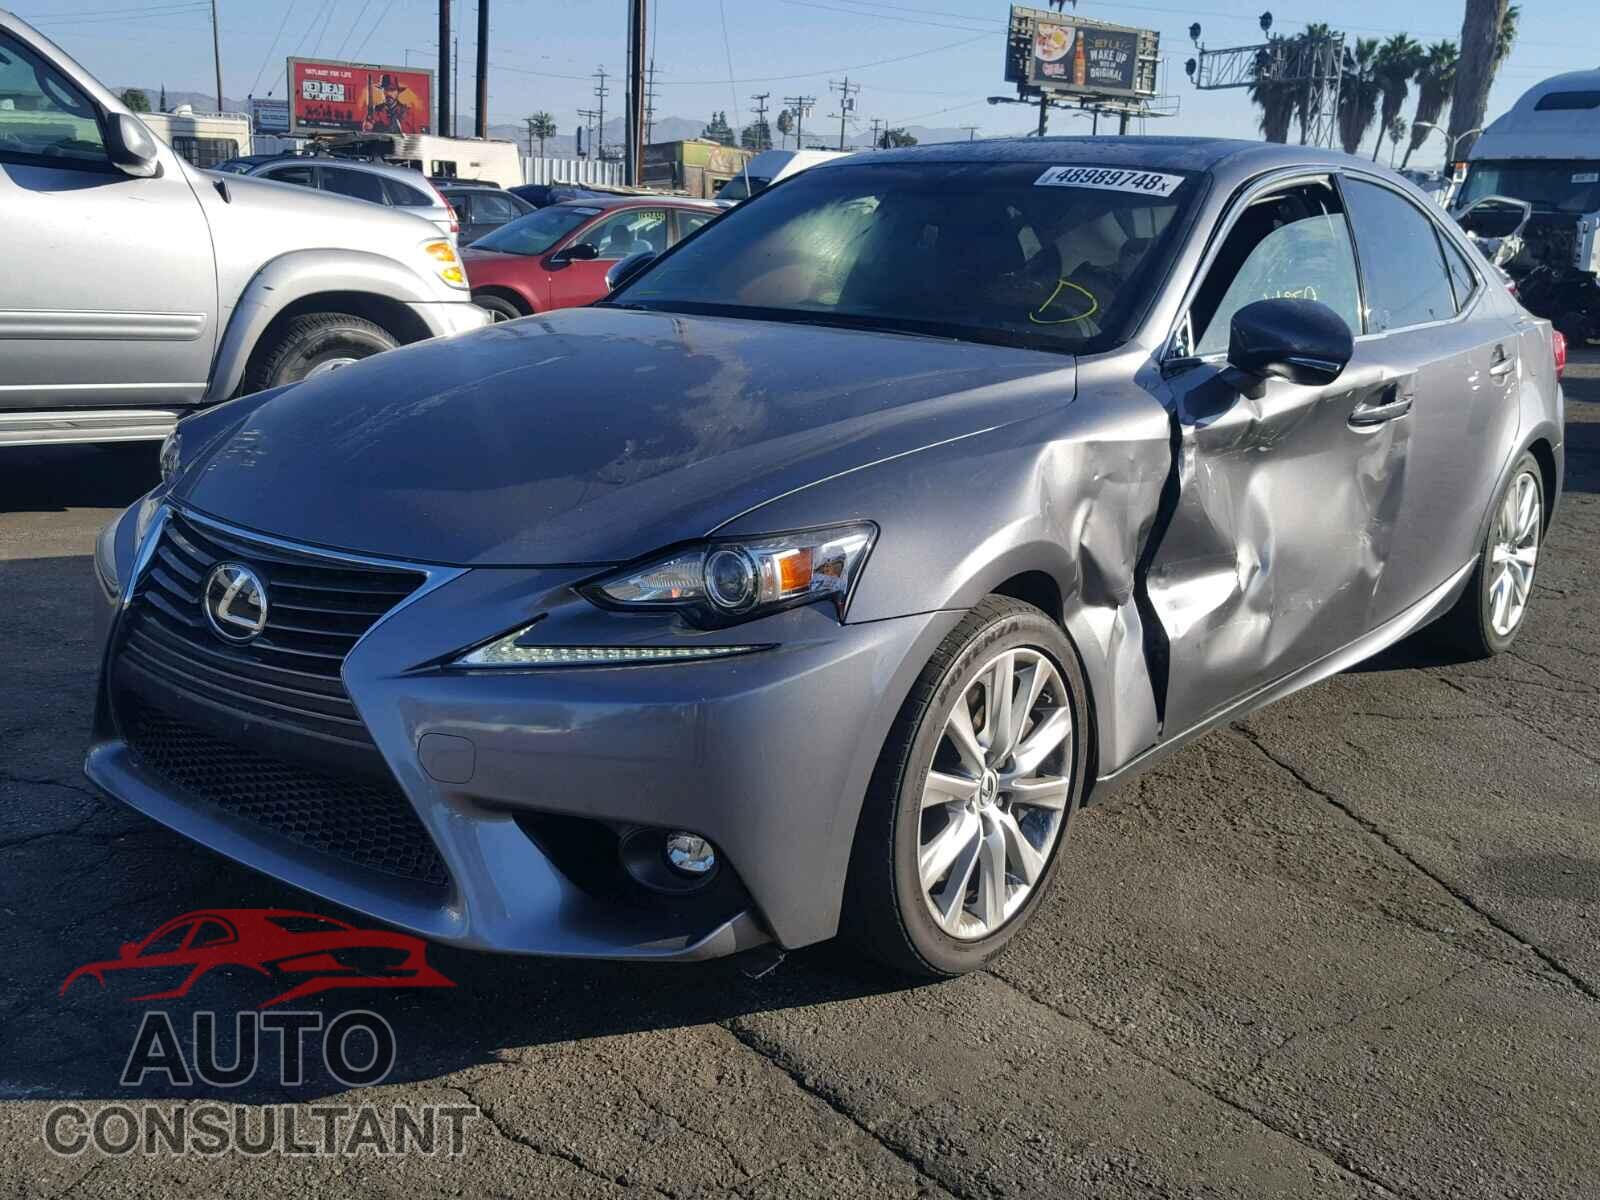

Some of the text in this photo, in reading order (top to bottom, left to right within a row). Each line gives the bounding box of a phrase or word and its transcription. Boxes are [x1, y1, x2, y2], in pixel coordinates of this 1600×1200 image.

[1090, 49, 1128, 64] WAKE UP
[302, 80, 344, 96] RED DEAD
[1029, 279, 1099, 324] D
[938, 621, 1020, 706] POTENZA
